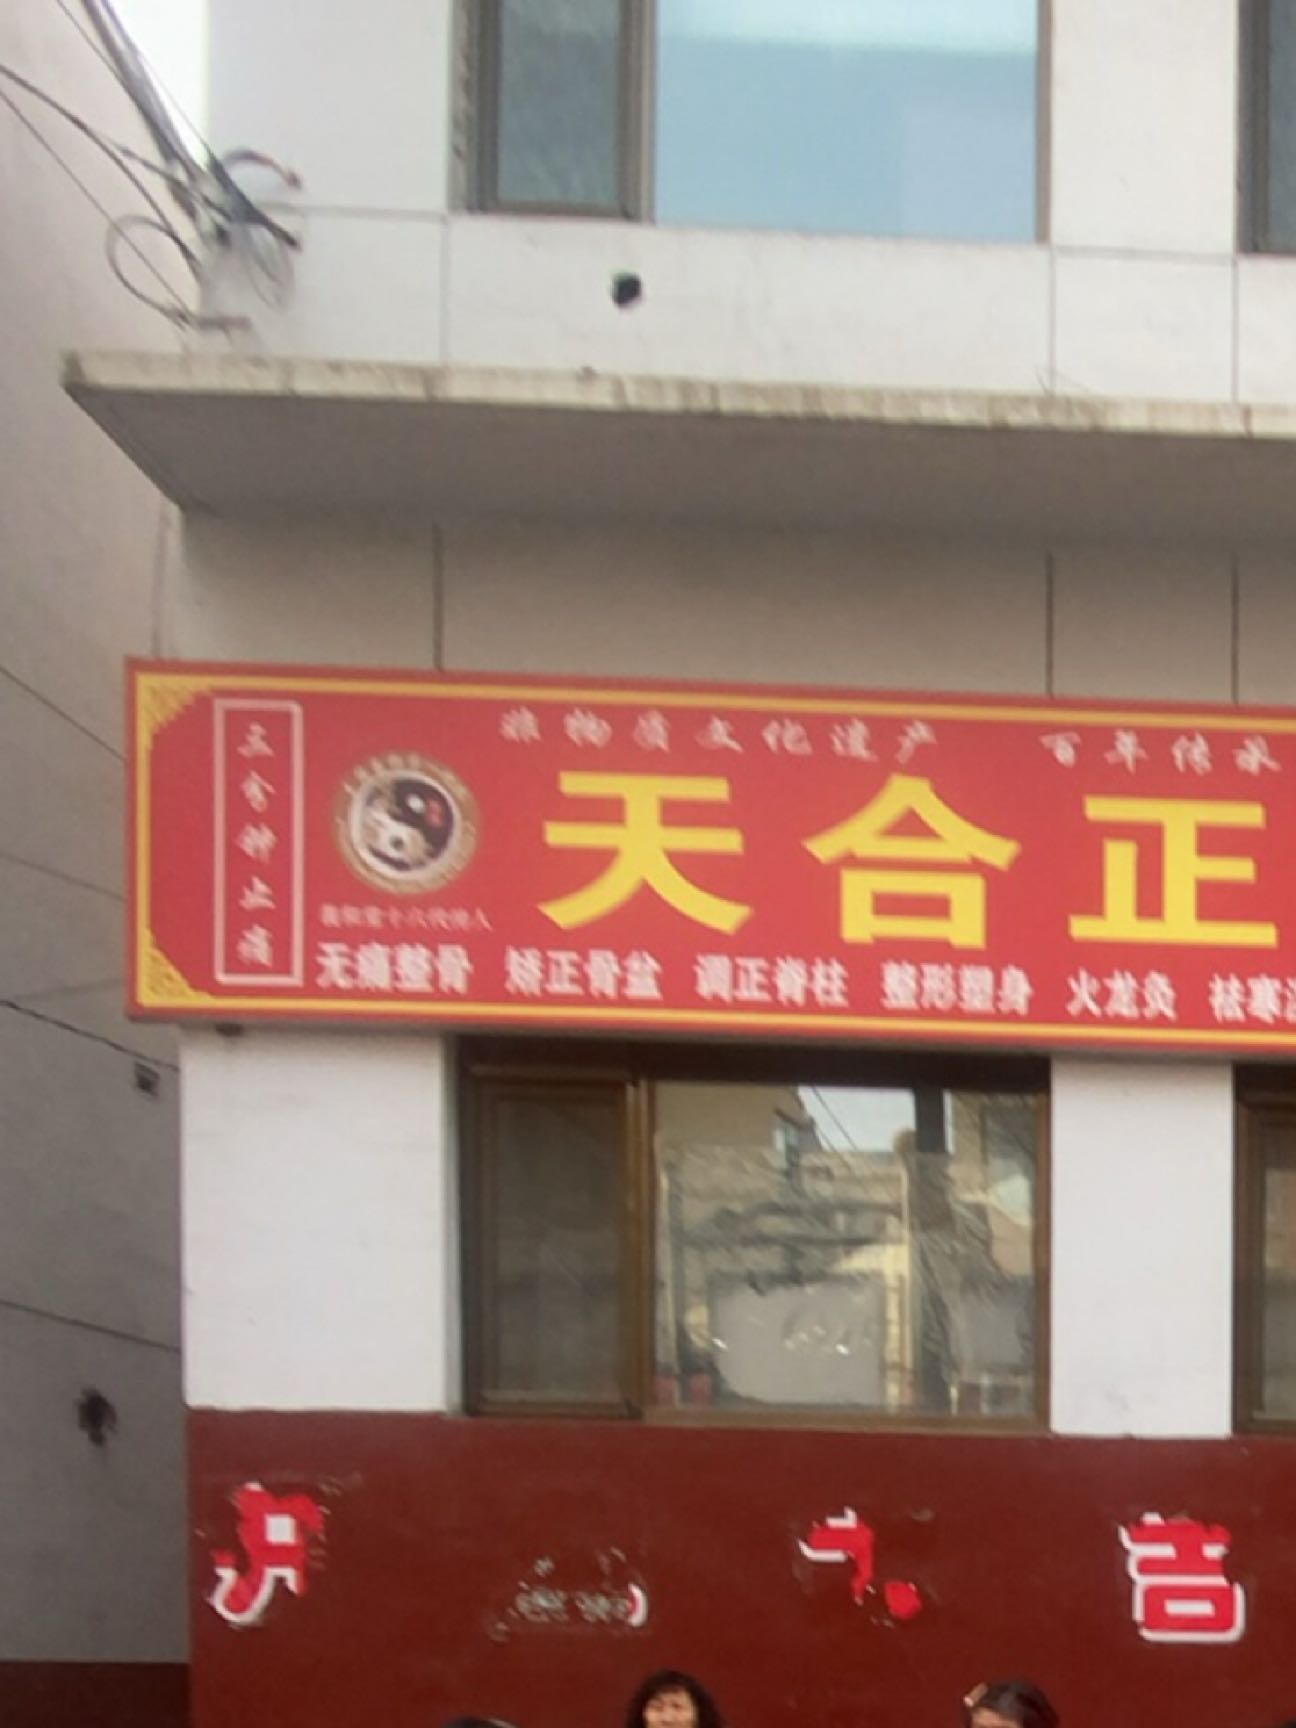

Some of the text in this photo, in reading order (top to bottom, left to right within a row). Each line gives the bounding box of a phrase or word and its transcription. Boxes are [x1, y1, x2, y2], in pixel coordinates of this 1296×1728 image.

[316, 942, 475, 995] 无痛整骨
[504, 946, 663, 1001] 矫正骨盆
[880, 960, 1034, 1017] 整形塑身
[1066, 969, 1178, 1021] 火龙灸
